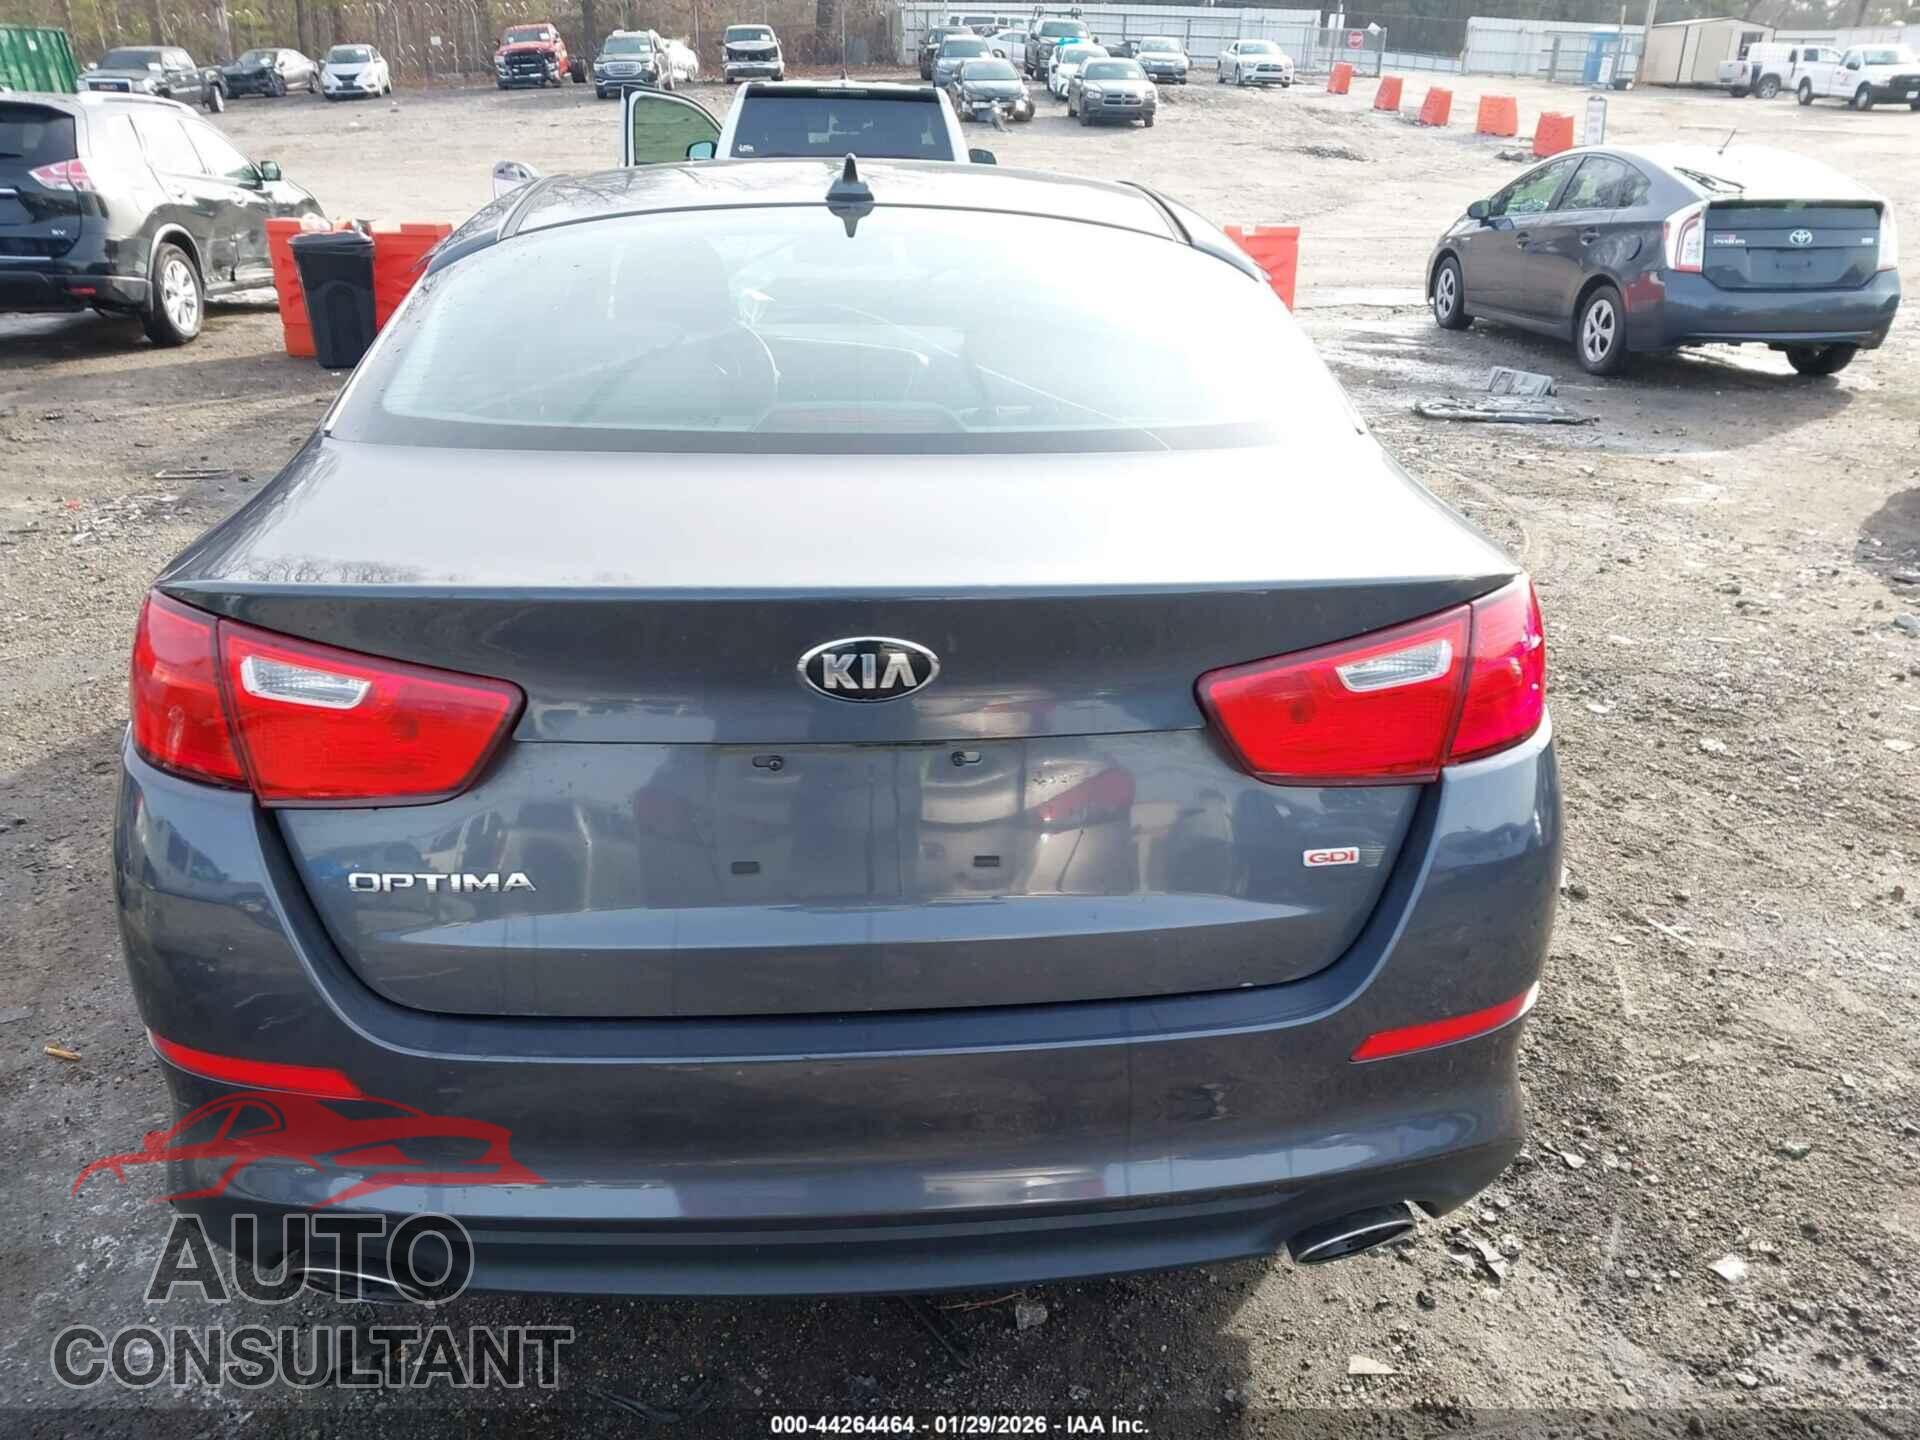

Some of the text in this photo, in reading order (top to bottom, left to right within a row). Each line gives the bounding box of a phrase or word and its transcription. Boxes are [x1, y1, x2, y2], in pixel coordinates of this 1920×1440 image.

[821, 653, 918, 690] KIA
[1309, 850, 1355, 864] GDI
[347, 871, 537, 894] OPTIMA
